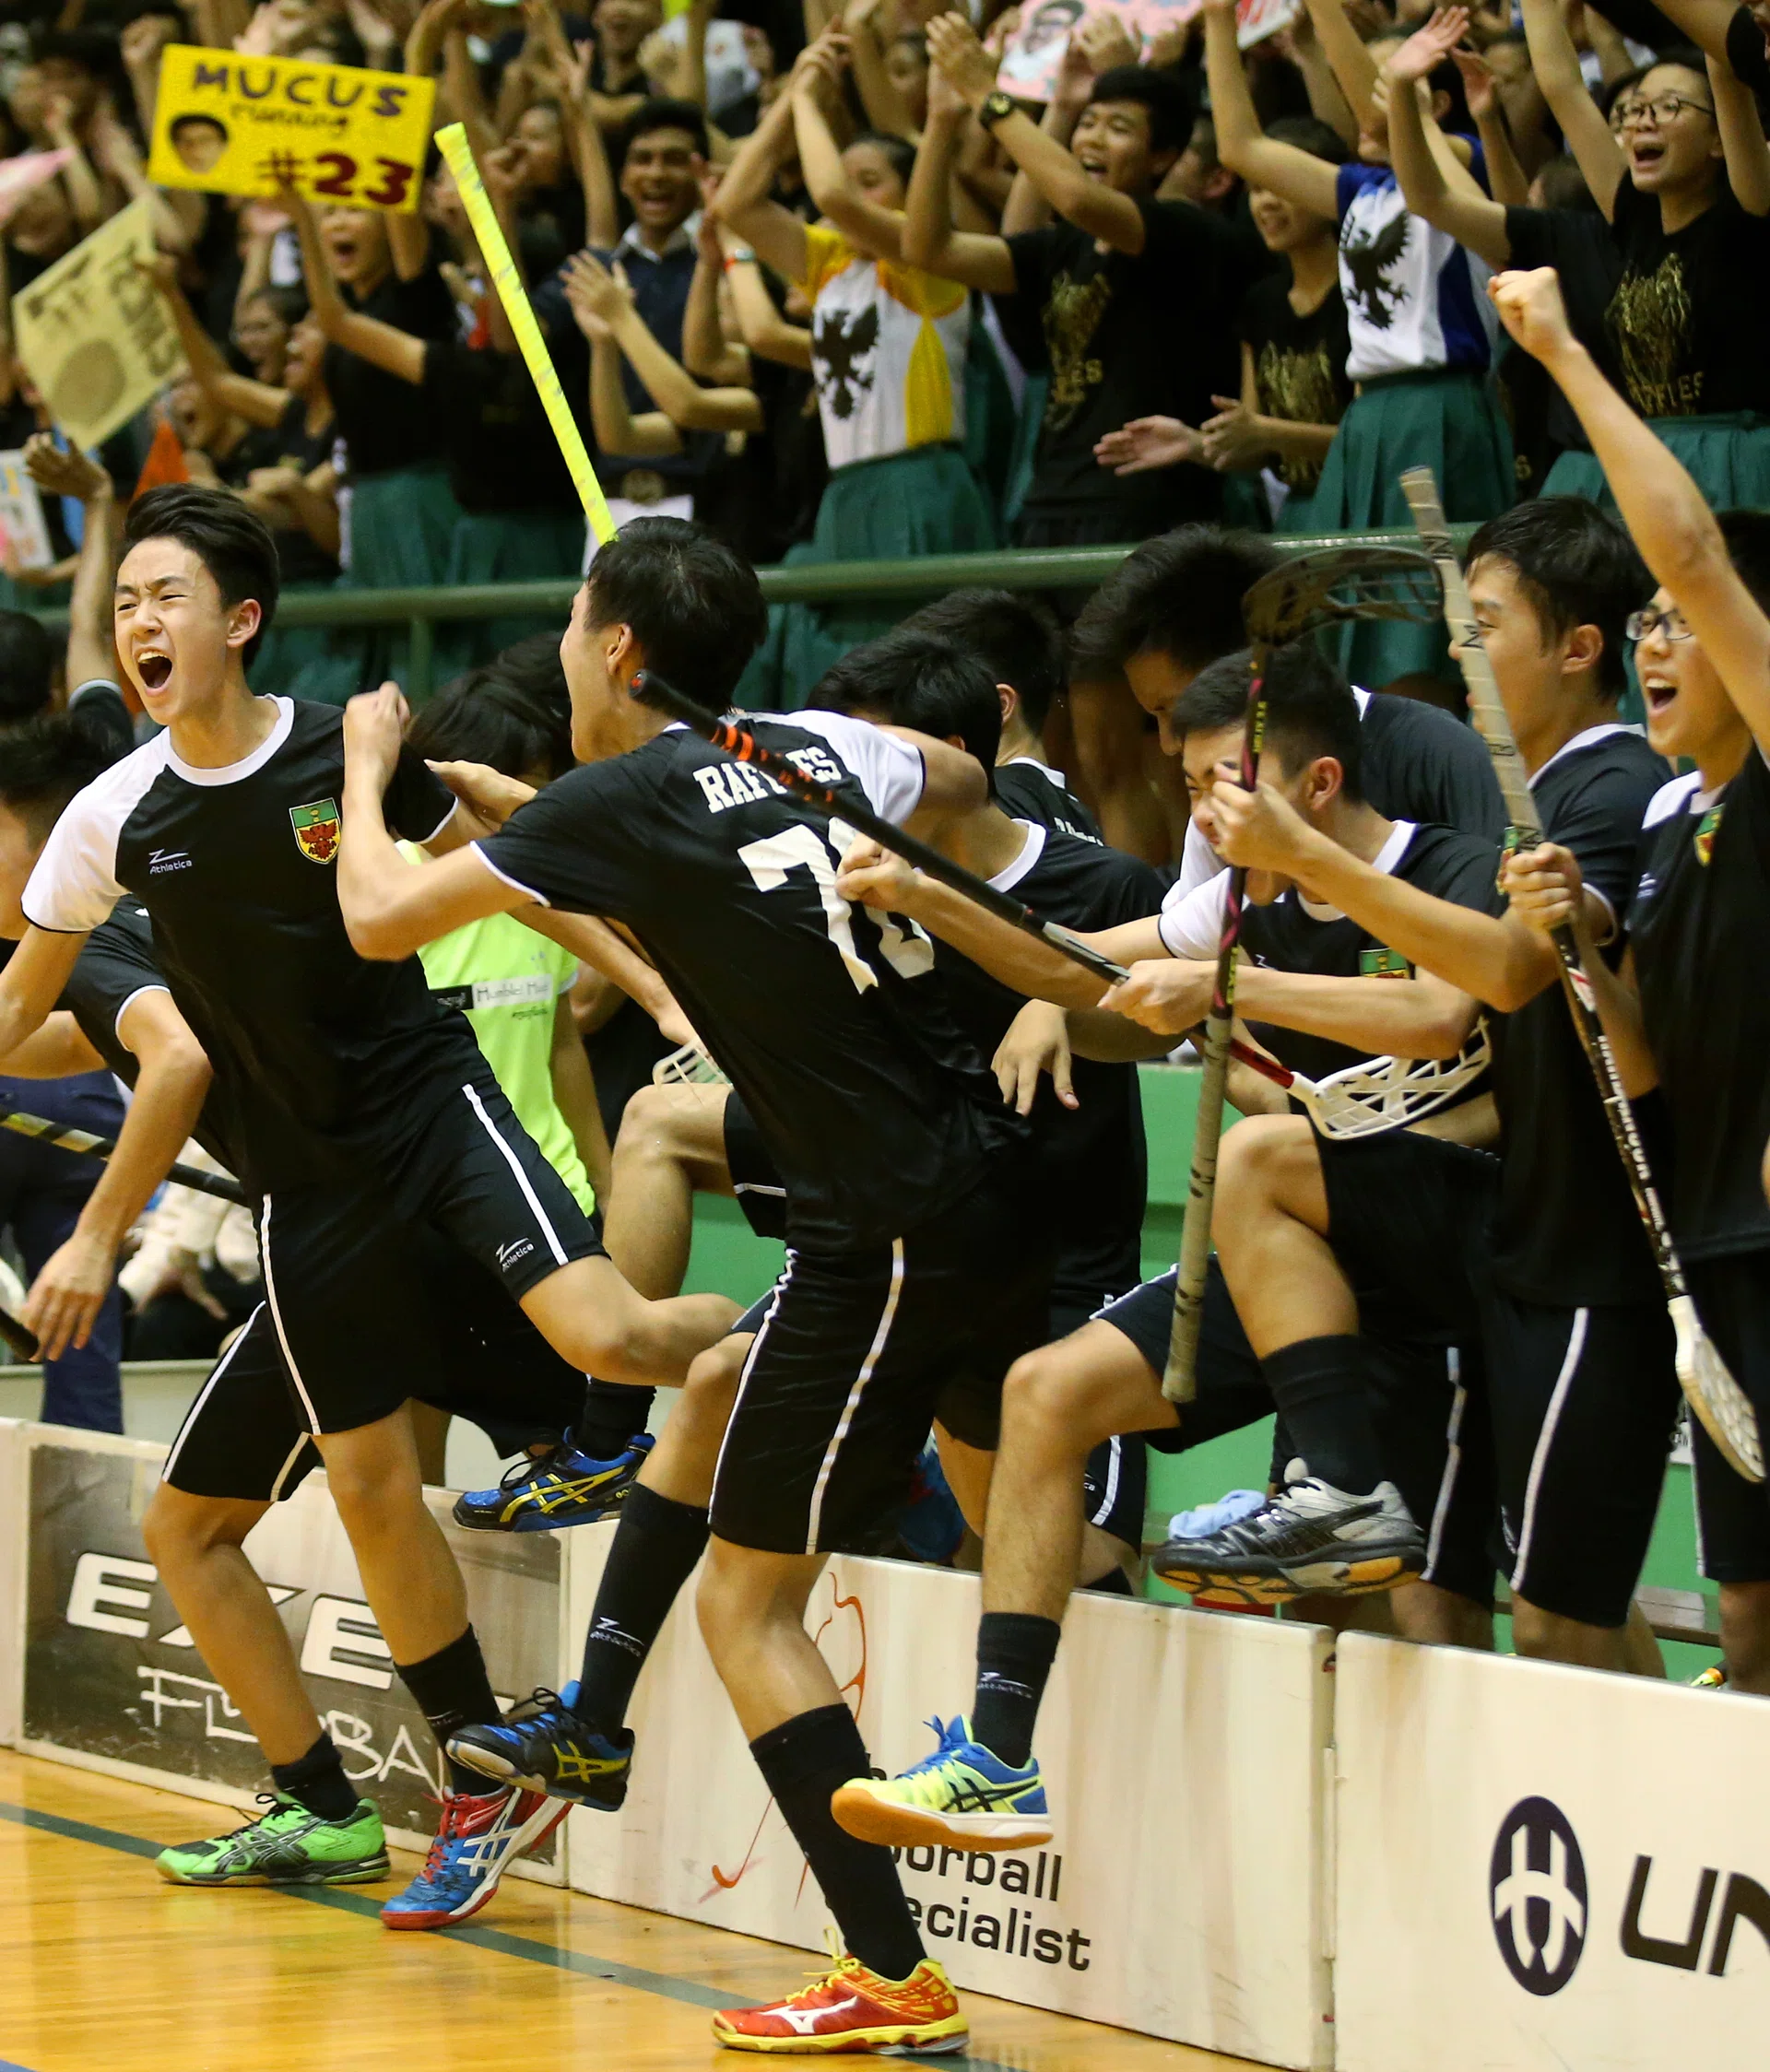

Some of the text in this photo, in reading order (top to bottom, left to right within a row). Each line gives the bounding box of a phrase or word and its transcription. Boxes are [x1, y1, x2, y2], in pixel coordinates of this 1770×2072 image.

[194, 63, 407, 117] MUCUS
[254, 147, 414, 205] #23
[693, 746, 842, 814] RAFES
[893, 1844, 1062, 1902] orball
[907, 1895, 1091, 1972] ecialist
